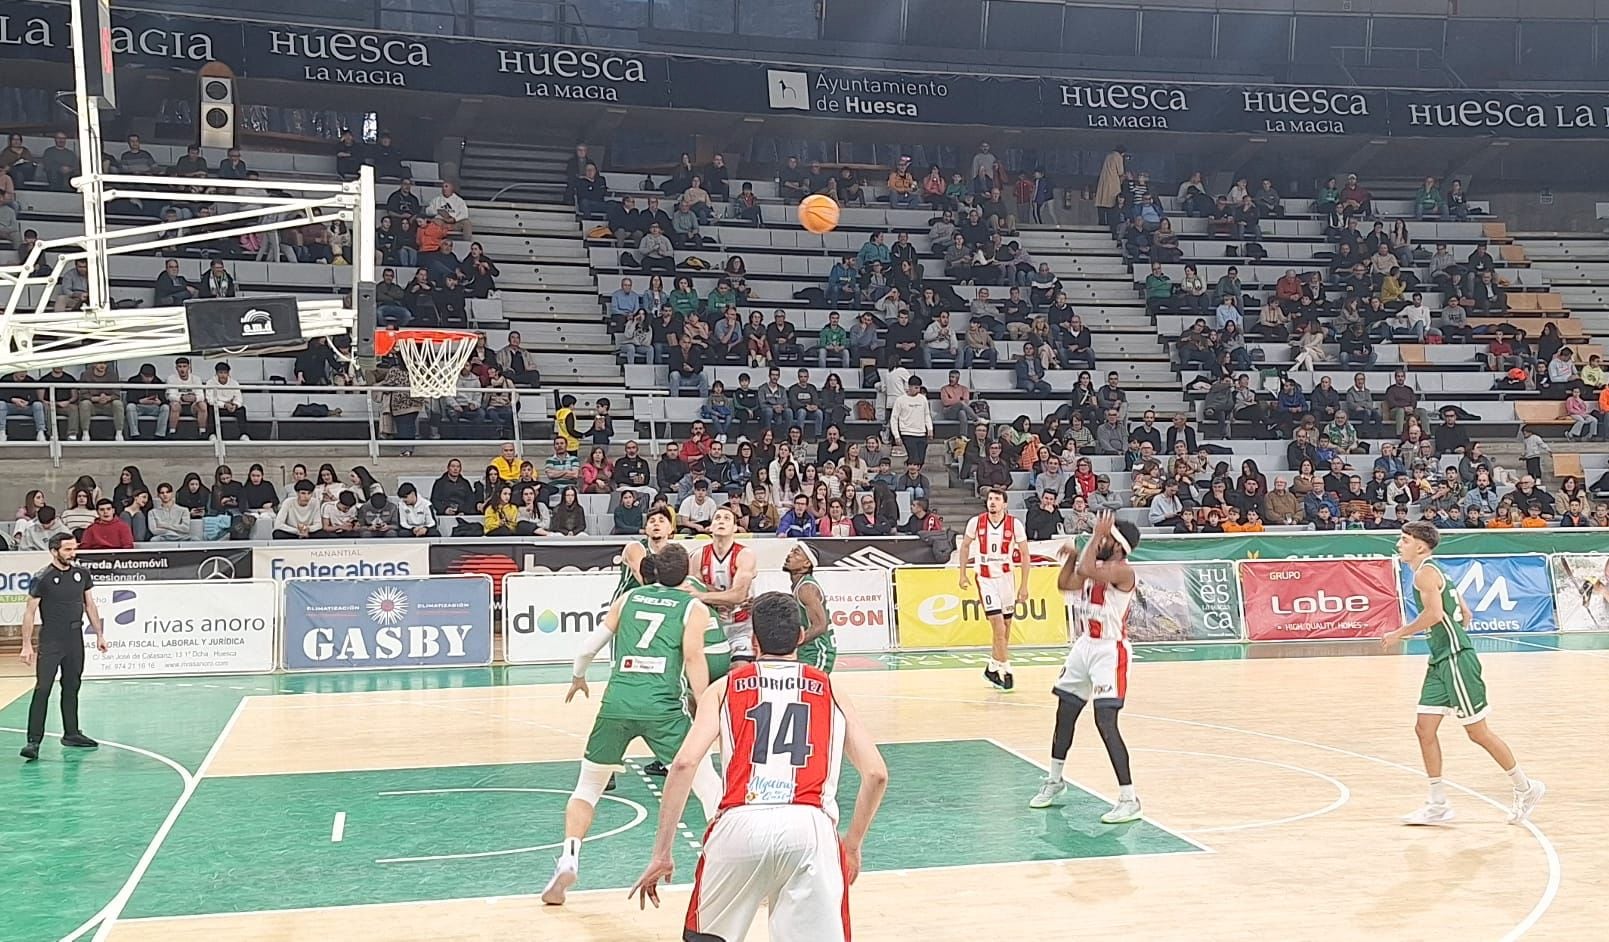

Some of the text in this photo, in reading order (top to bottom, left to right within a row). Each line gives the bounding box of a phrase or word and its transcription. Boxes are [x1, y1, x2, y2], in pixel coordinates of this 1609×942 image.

[816, 74, 948, 97] Ayuntamiento
[816, 95, 918, 117] de Huesca
[310, 549, 362, 558] MANANTIAL
[113, 558, 168, 569] Automóvil
[1269, 571, 1301, 581] GRUPO
[854, 594, 882, 602] CARRY
[1271, 589, 1369, 614] Lobe
[144, 615, 265, 633] rivas anoro
[832, 605, 884, 626] GÓN
[635, 611, 666, 649] 7
[1285, 621, 1362, 631] HIGH QUALITY HOMES
[85, 640, 126, 649] ASORÍA
[161, 639, 200, 647] LABORAL
[208, 637, 245, 646] JURÍDICA
[303, 625, 473, 661] GASBY
[747, 701, 812, 766] 14
